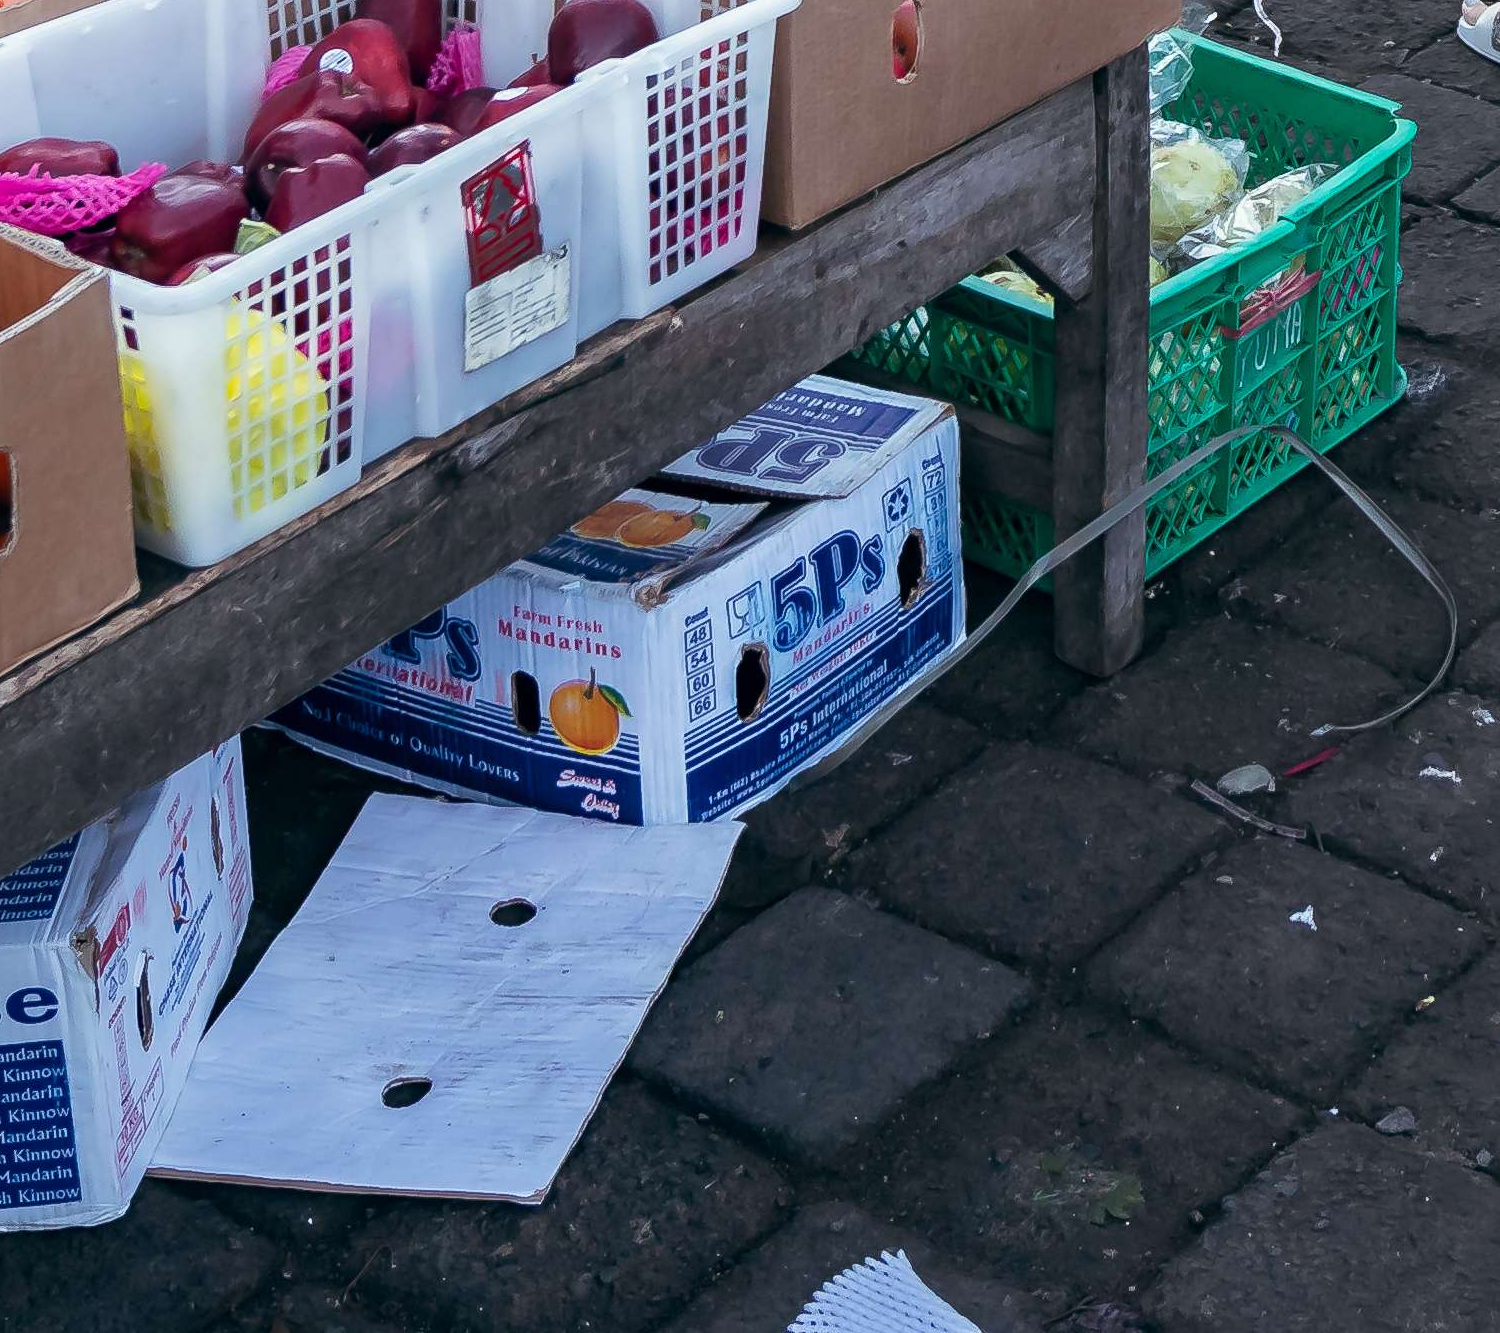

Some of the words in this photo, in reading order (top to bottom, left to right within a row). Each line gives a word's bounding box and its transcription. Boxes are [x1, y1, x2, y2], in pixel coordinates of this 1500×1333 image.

[770, 529, 886, 652] 5Ps
[512, 604, 553, 627] Farm
[556, 614, 605, 635] Fresh
[381, 605, 484, 682] Ps
[498, 618, 624, 660] Mandarins
[689, 627, 708, 645] 48
[690, 651, 709, 670] 54
[356, 658, 476, 704] ternational
[692, 674, 710, 693] 60
[694, 697, 713, 715] 66
[779, 714, 809, 749] 5Ps
[811, 658, 888, 728] International
[10, 864, 63, 876] ndarin
[0, 878, 63, 892] Kinnow
[2, 1064, 66, 1082] Kinnow
[7, 1105, 71, 1123] Kinnow
[12, 1145, 76, 1162] Kinnow
[18, 1185, 81, 1203] Kinnow
